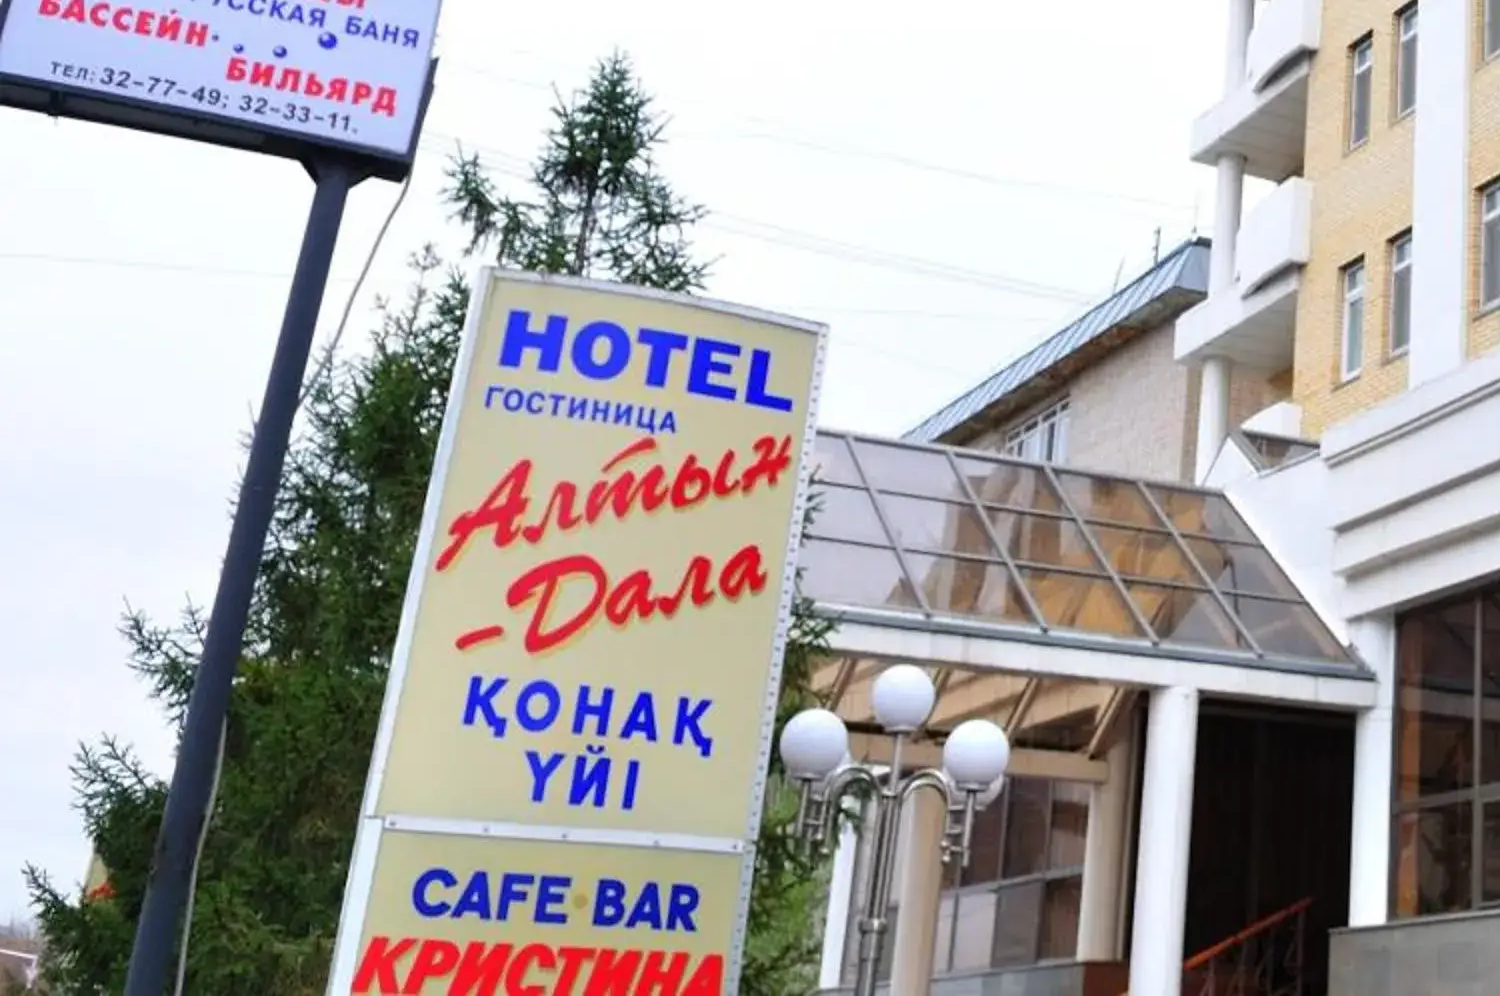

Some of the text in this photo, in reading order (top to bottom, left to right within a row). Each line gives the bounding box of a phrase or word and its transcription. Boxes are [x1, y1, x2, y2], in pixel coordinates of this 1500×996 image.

[345, 15, 420, 49] БАНЯ
[51, 61, 97, 83] ТЕЛ:
[226, 57, 397, 117] БИЛЬЯРД
[499, 310, 793, 412] HOTEL
[485, 385, 677, 435] ГОСТИНИЦА
[436, 434, 793, 572] Алтын
[463, 676, 713, 757] ҚОНАҚ
[412, 868, 701, 932] CAFE BAR
[350, 936, 724, 996] КРИСТИНА
